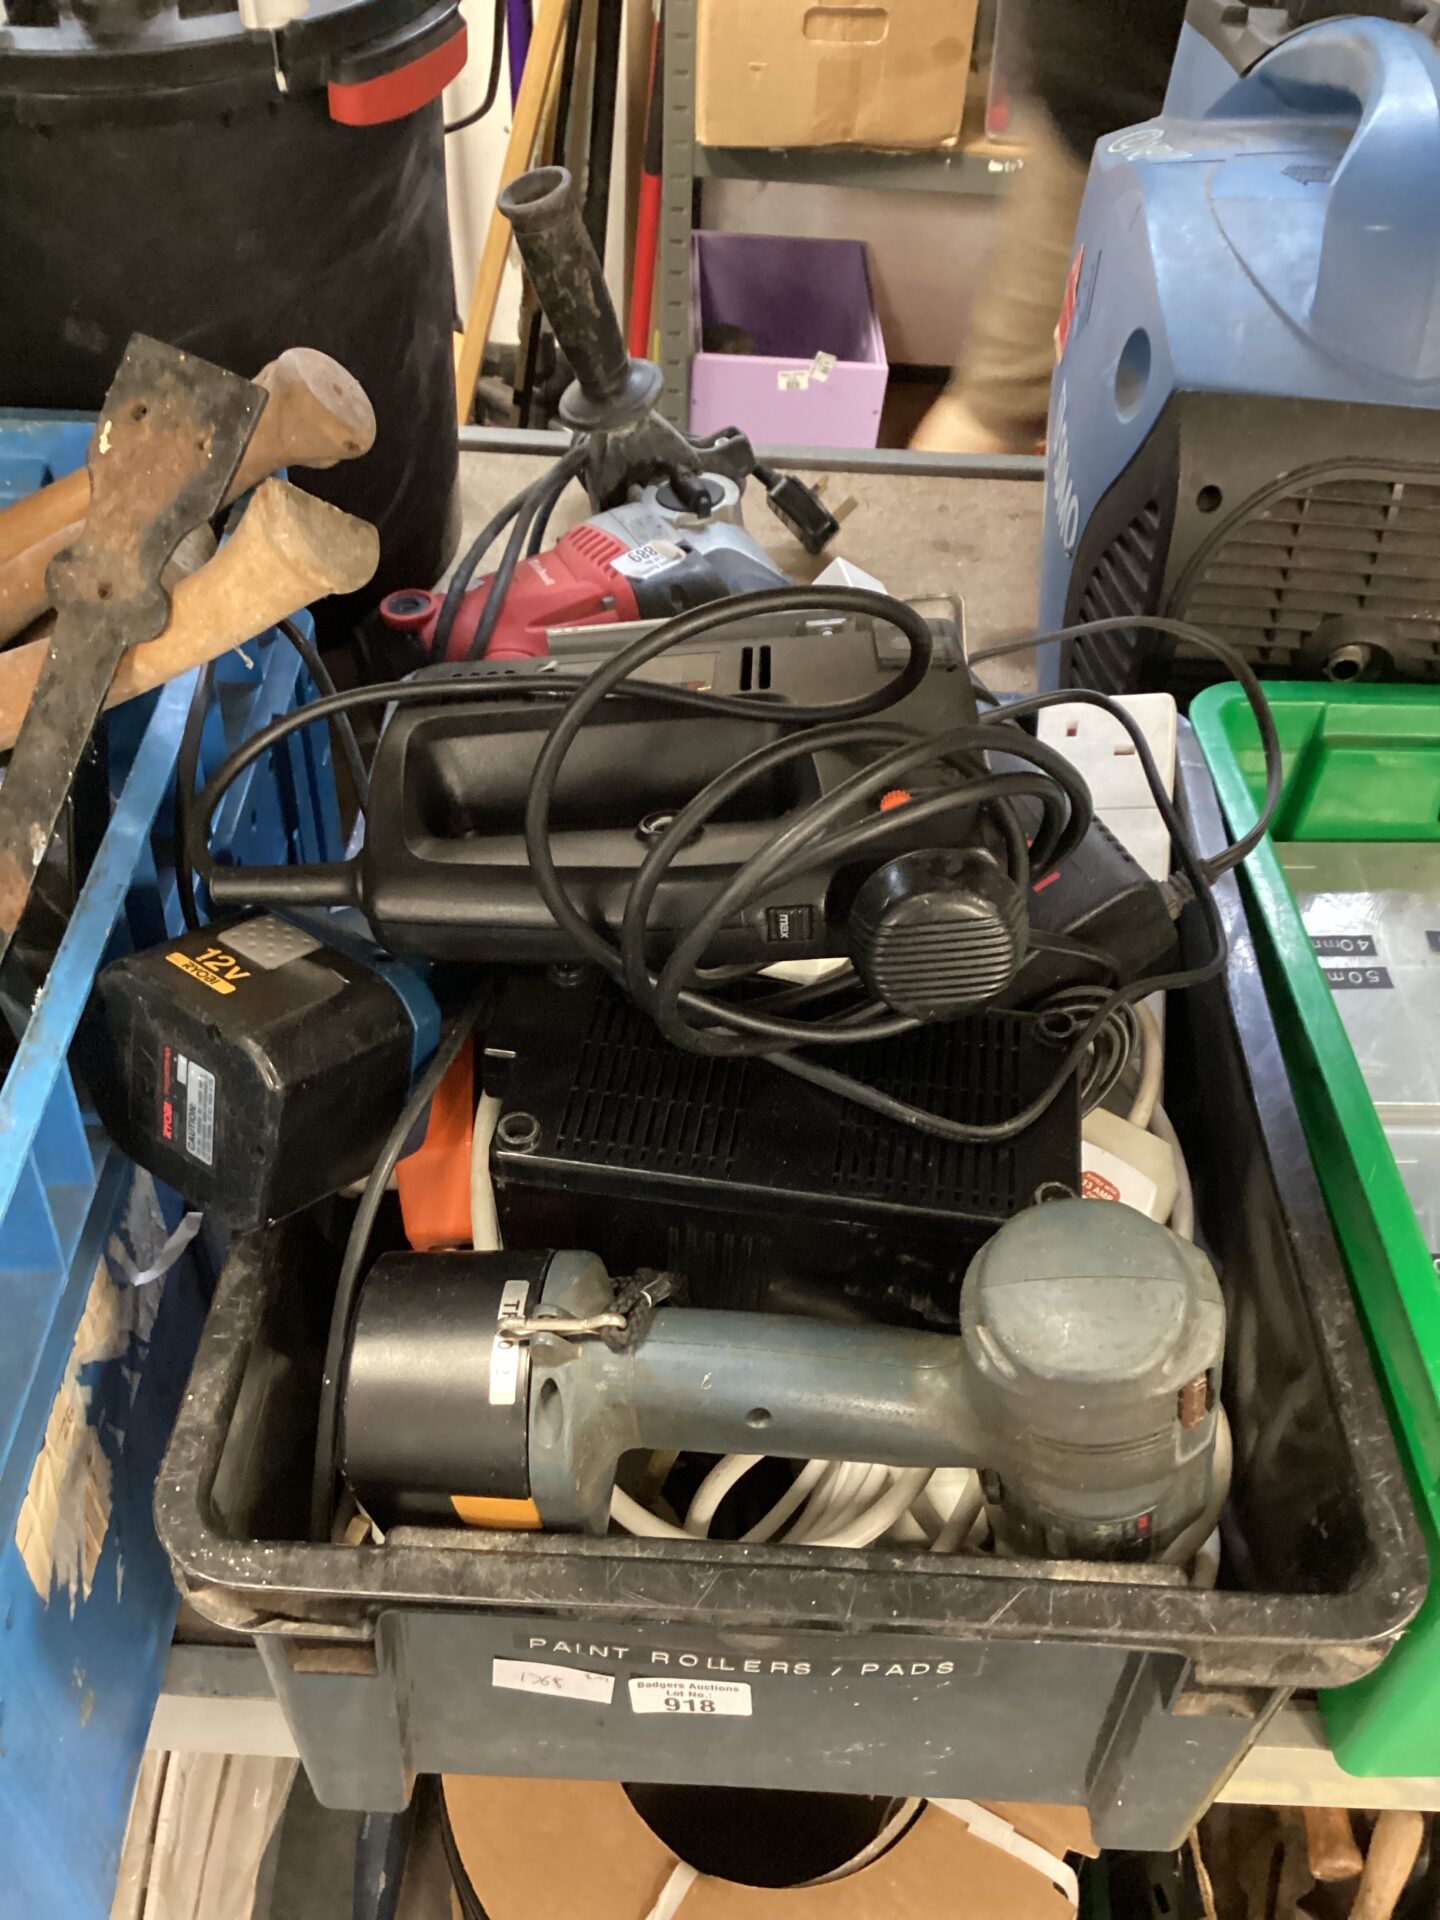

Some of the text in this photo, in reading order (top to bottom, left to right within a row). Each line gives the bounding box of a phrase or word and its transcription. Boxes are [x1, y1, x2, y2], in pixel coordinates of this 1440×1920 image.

[779, 914, 789, 939] max
[182, 961, 221, 985] RYOBI
[195, 947, 251, 980] 12V
[529, 1637, 630, 1660] PAINT
[651, 1650, 812, 1676] ROLLERS
[860, 1661, 955, 1676] PADS
[637, 1681, 740, 1692] Badgers Auctions
[664, 1697, 716, 1713] 918
